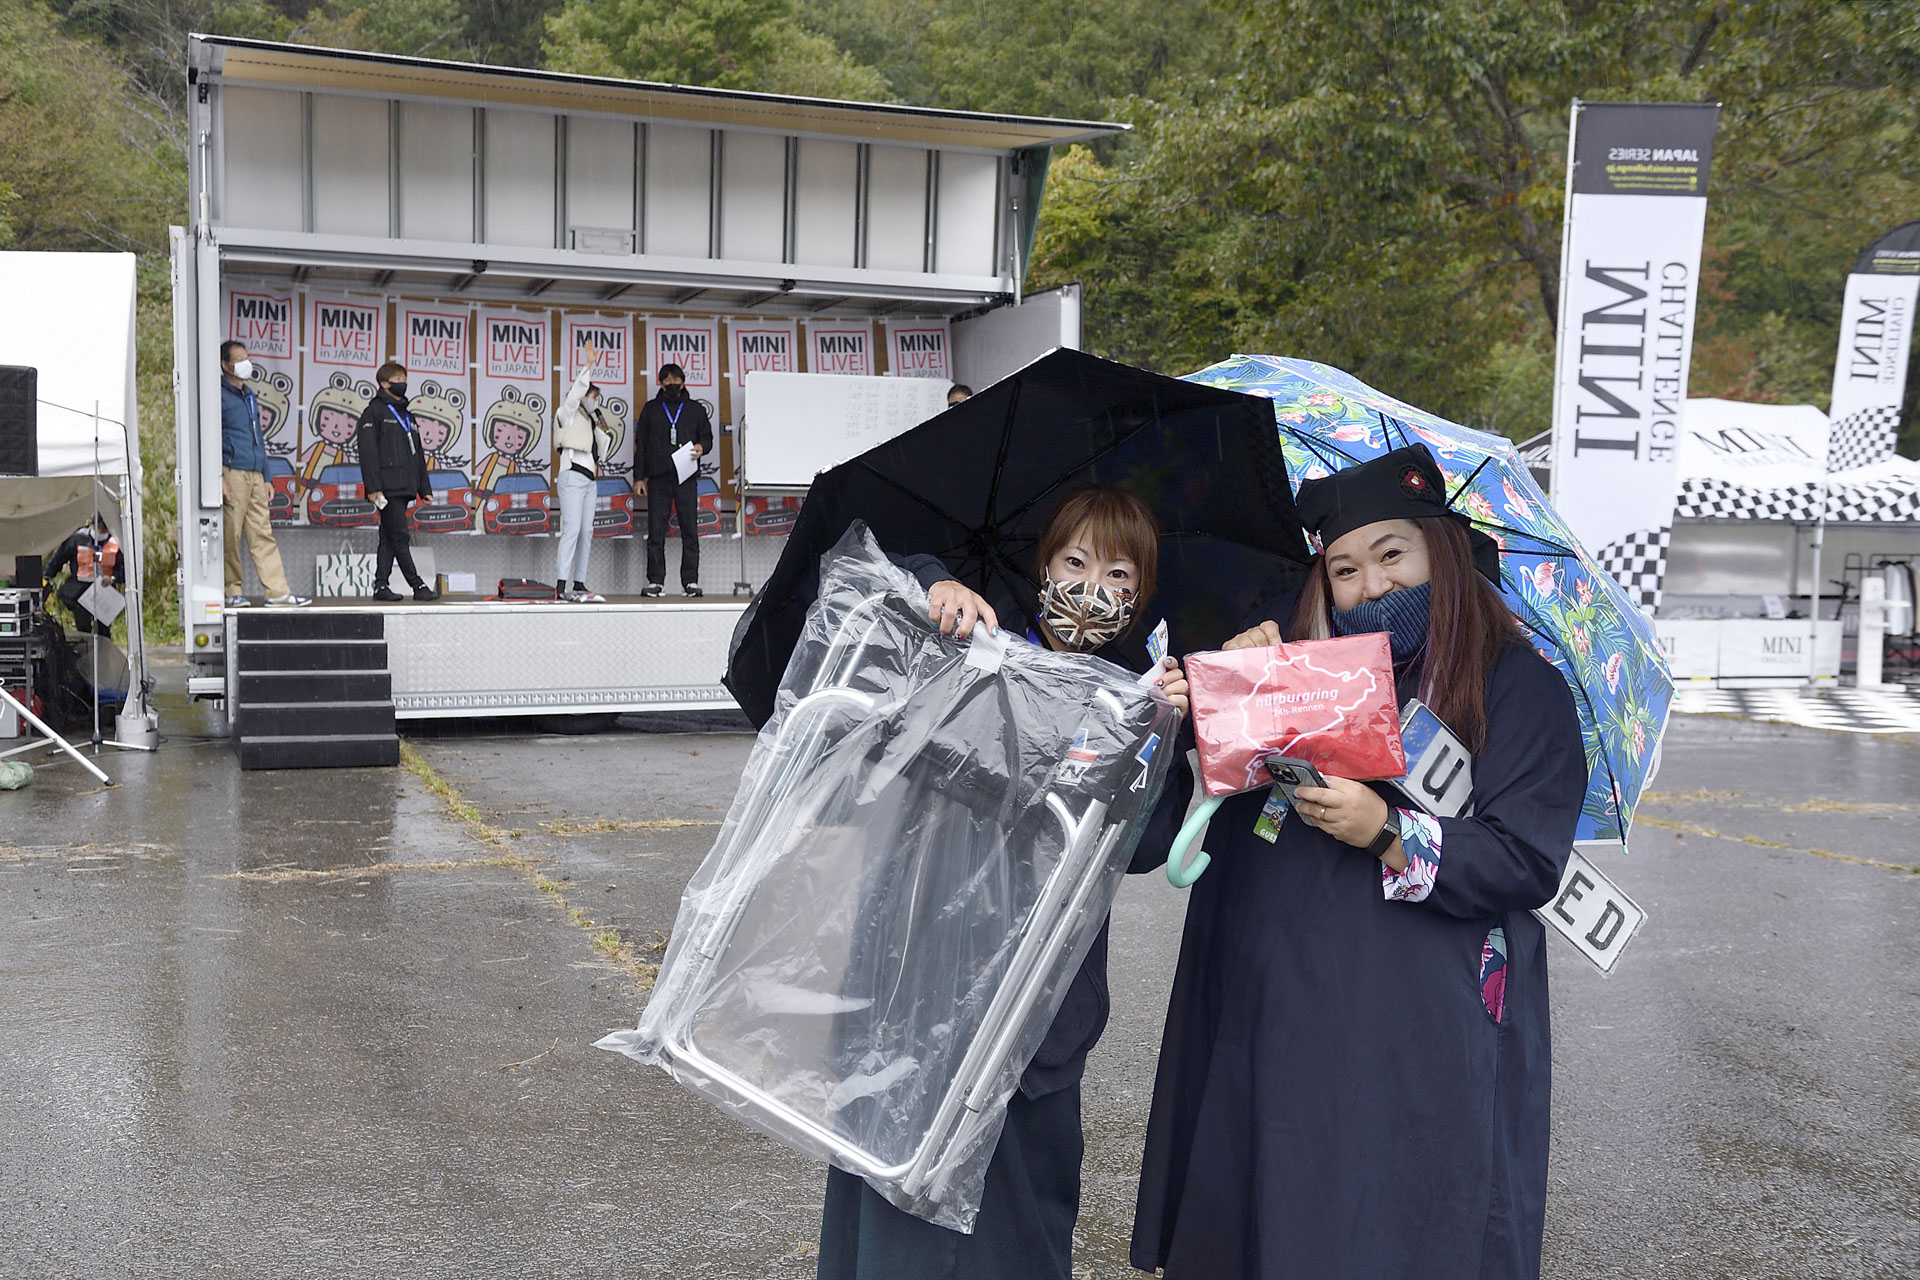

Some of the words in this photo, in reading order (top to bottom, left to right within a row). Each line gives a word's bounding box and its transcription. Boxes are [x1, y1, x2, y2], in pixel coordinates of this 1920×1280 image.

[236, 299, 286, 322] MINI
[321, 308, 372, 331] MINI
[236, 319, 286, 342] LIVE!
[412, 318, 461, 340] MINI
[492, 324, 540, 345] MINI
[249, 341, 286, 353] JAPAN.
[321, 328, 371, 351] LIVE!
[412, 337, 460, 359] LIVE!
[576, 330, 621, 349] MINI
[661, 334, 706, 352] MINI
[743, 336, 785, 353] MINI
[820, 336, 862, 353] MINI
[900, 334, 941, 351] MINI
[320, 348, 331, 358] in
[332, 349, 371, 362] JAPAN.
[492, 344, 539, 364] LIVE!
[576, 349, 621, 369] LVE!
[743, 354, 787, 371] LIVE!
[821, 354, 863, 371] LIVE!
[901, 352, 942, 369] LIVE!
[411, 357, 421, 367] in
[424, 358, 460, 370] JAPAN.
[491, 363, 502, 373] in
[504, 363, 539, 375] JAPAN.
[591, 369, 621, 379] APAN.
[685, 371, 706, 381] PAN.
[1762, 636, 1802, 654] MINI
[1255, 688, 1338, 708] nürburgring
